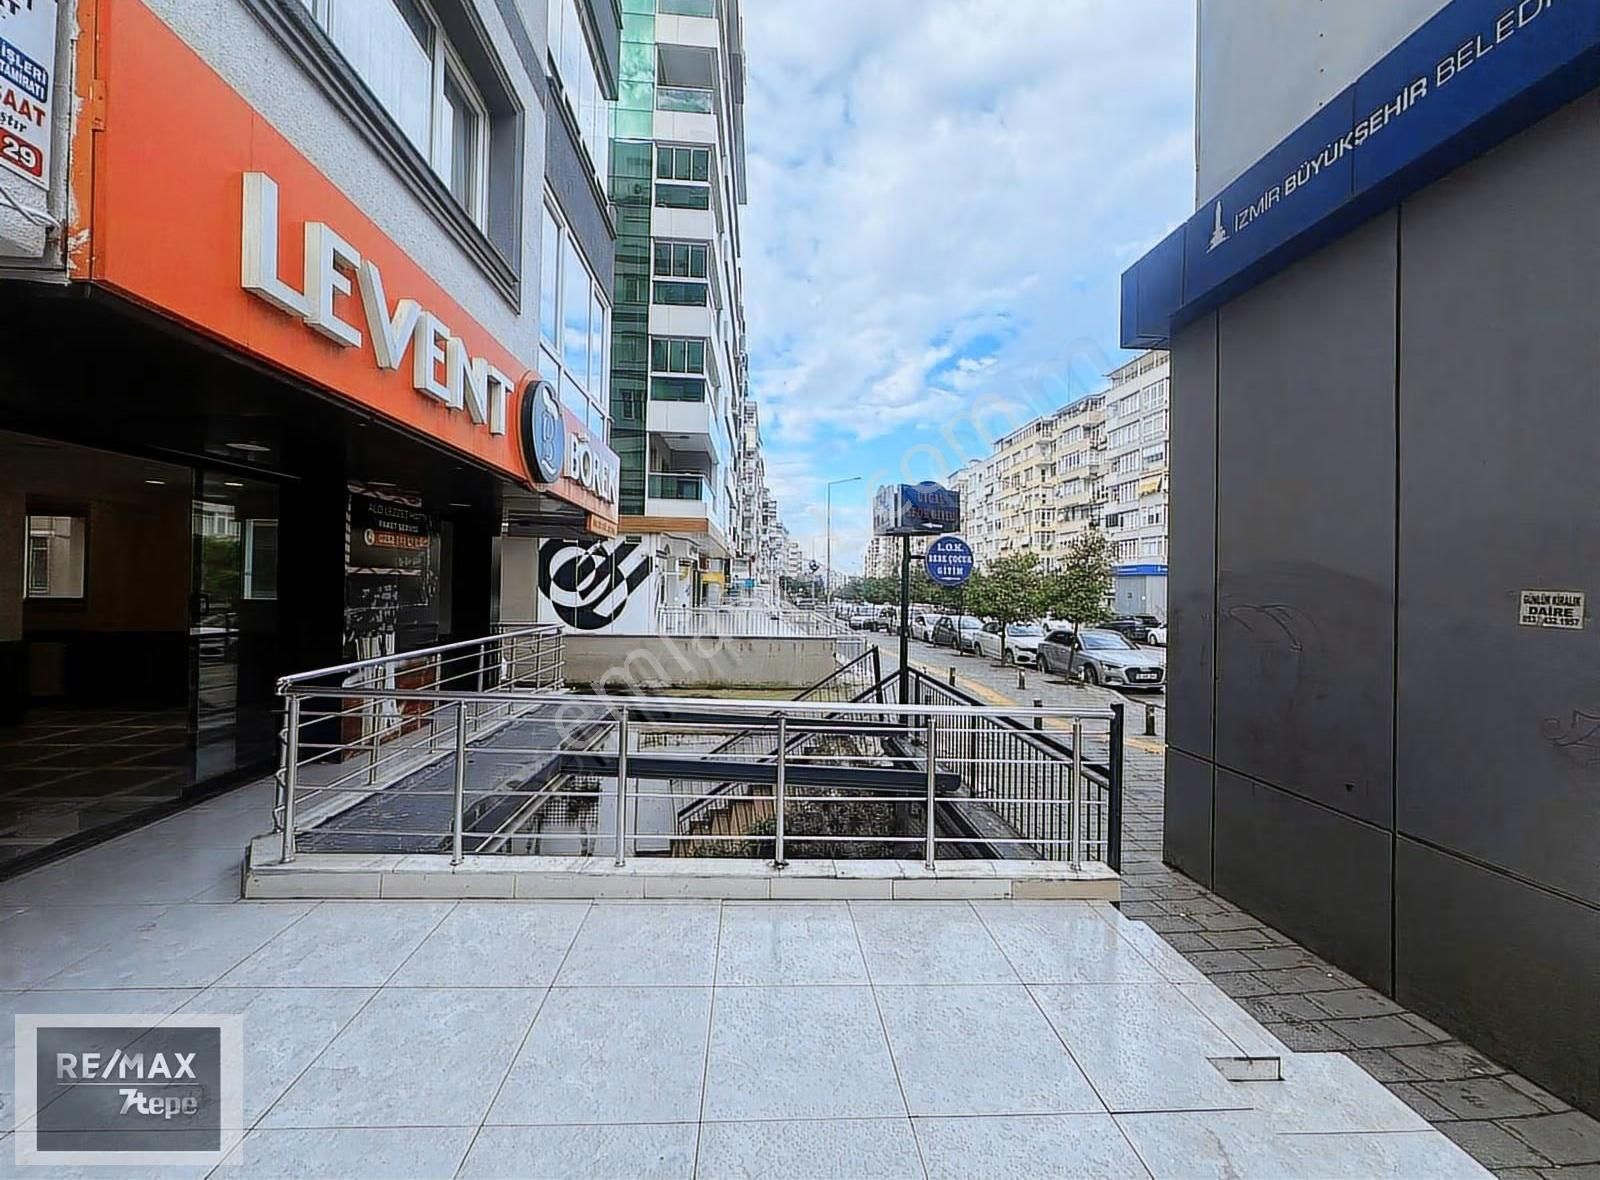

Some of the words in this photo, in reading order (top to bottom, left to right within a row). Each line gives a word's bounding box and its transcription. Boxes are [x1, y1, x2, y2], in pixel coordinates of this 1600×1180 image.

[0, 87, 46, 127] AAT
[3, 136, 36, 168] 29
[241, 171, 515, 435] LEVENT
